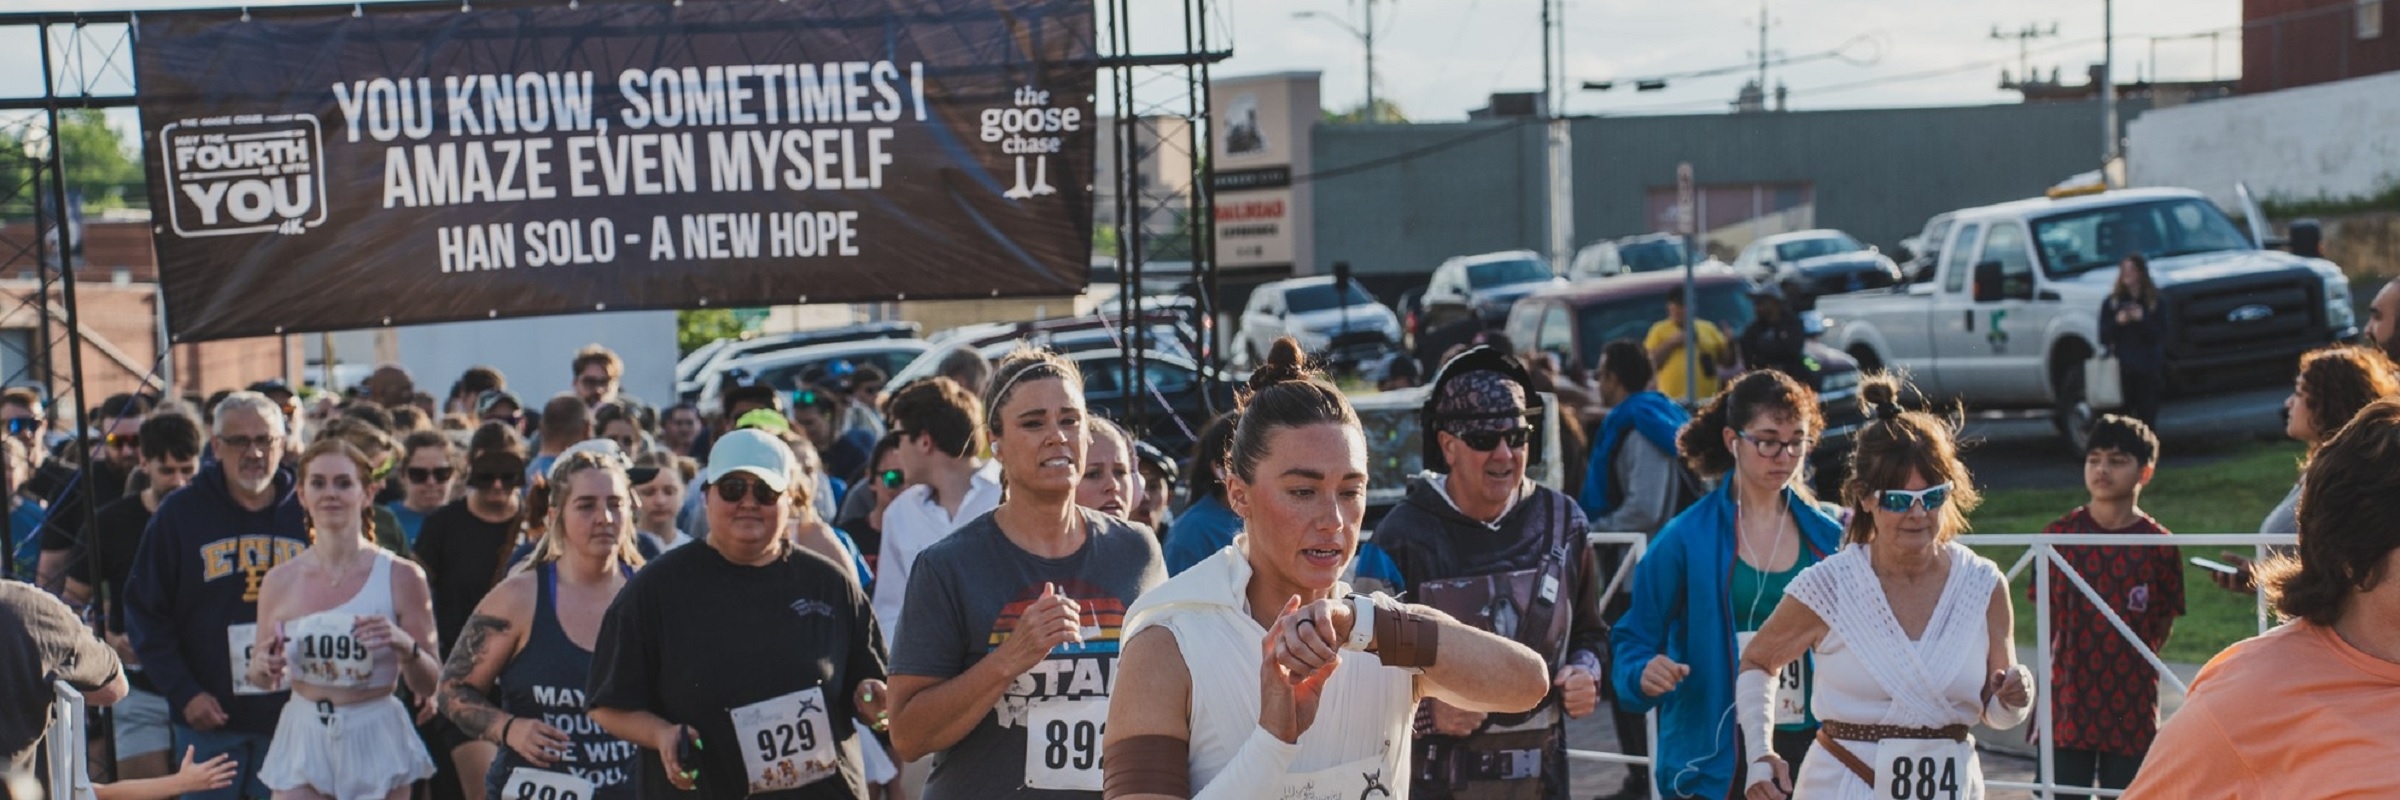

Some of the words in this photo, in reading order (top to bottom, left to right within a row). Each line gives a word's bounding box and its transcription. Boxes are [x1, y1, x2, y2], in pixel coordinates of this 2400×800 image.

[332, 78, 433, 142] YOU
[445, 71, 607, 136] KNOW,
[619, 61, 902, 128] SOMETIMES
[911, 62, 927, 121] I
[1014, 85, 1050, 106] the
[981, 107, 1081, 142] goose
[175, 138, 309, 171] FOURTH
[1002, 134, 1061, 153] chase
[383, 137, 557, 208] AMAZE
[567, 132, 696, 197] EVEN
[708, 128, 894, 192] MYSELF
[181, 174, 312, 225] YOU
[279, 218, 306, 235] 4K
[438, 223, 516, 273] HAN
[524, 217, 616, 267] SOLO
[650, 215, 676, 261] A
[682, 213, 761, 260] NEW
[770, 211, 859, 258] HOPE
[303, 634, 367, 660] 1095
[532, 685, 586, 707] MAY
[757, 719, 816, 762] 929
[1891, 756, 1958, 800] 884
